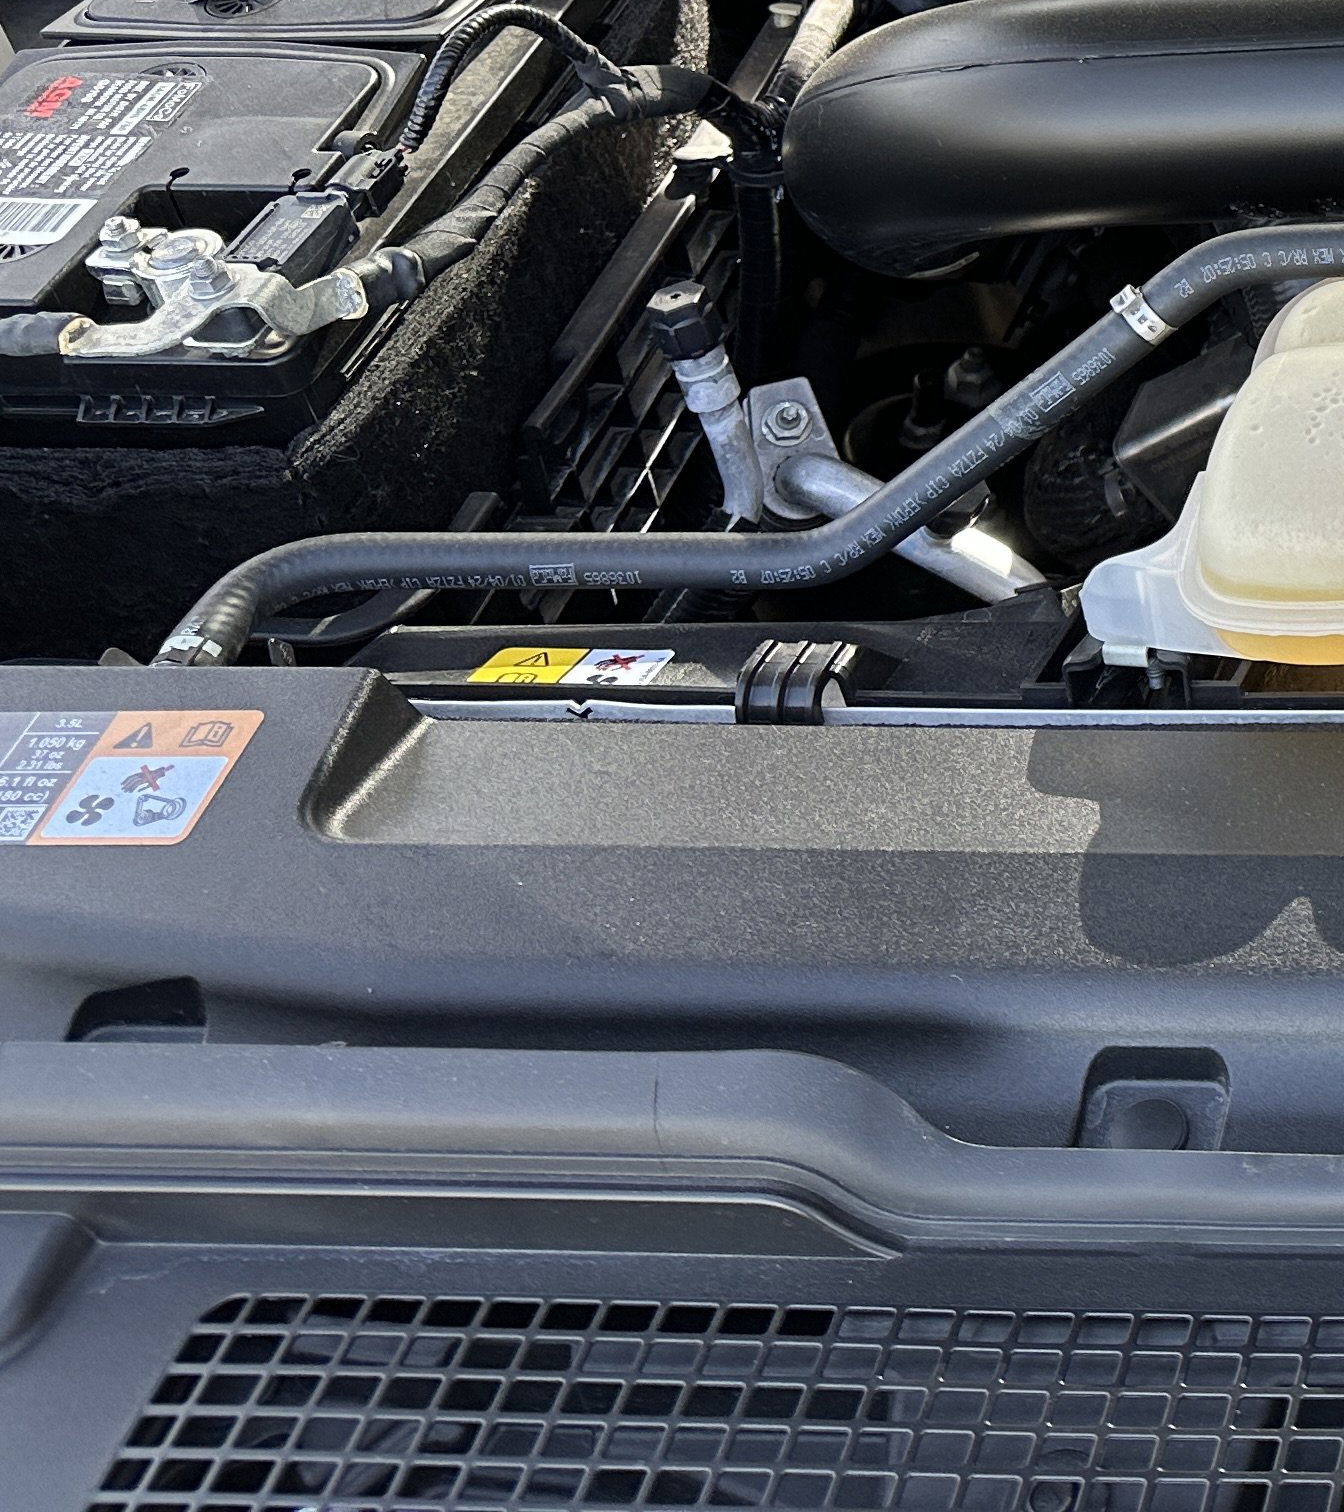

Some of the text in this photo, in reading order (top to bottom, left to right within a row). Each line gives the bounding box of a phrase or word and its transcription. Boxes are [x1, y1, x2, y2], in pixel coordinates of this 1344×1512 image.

[24, 76, 84, 118] AGM
[150, 82, 199, 121] FoMoCo
[584, 570, 642, 585] 1036865
[55, 718, 83, 728] 3.5L
[29, 736, 87, 751] 1.050 kg
[32, 749, 65, 759] 37 oz
[23, 776, 37, 787] fl
[37, 778, 58, 787] oz
[23, 790, 50, 803] cc)
